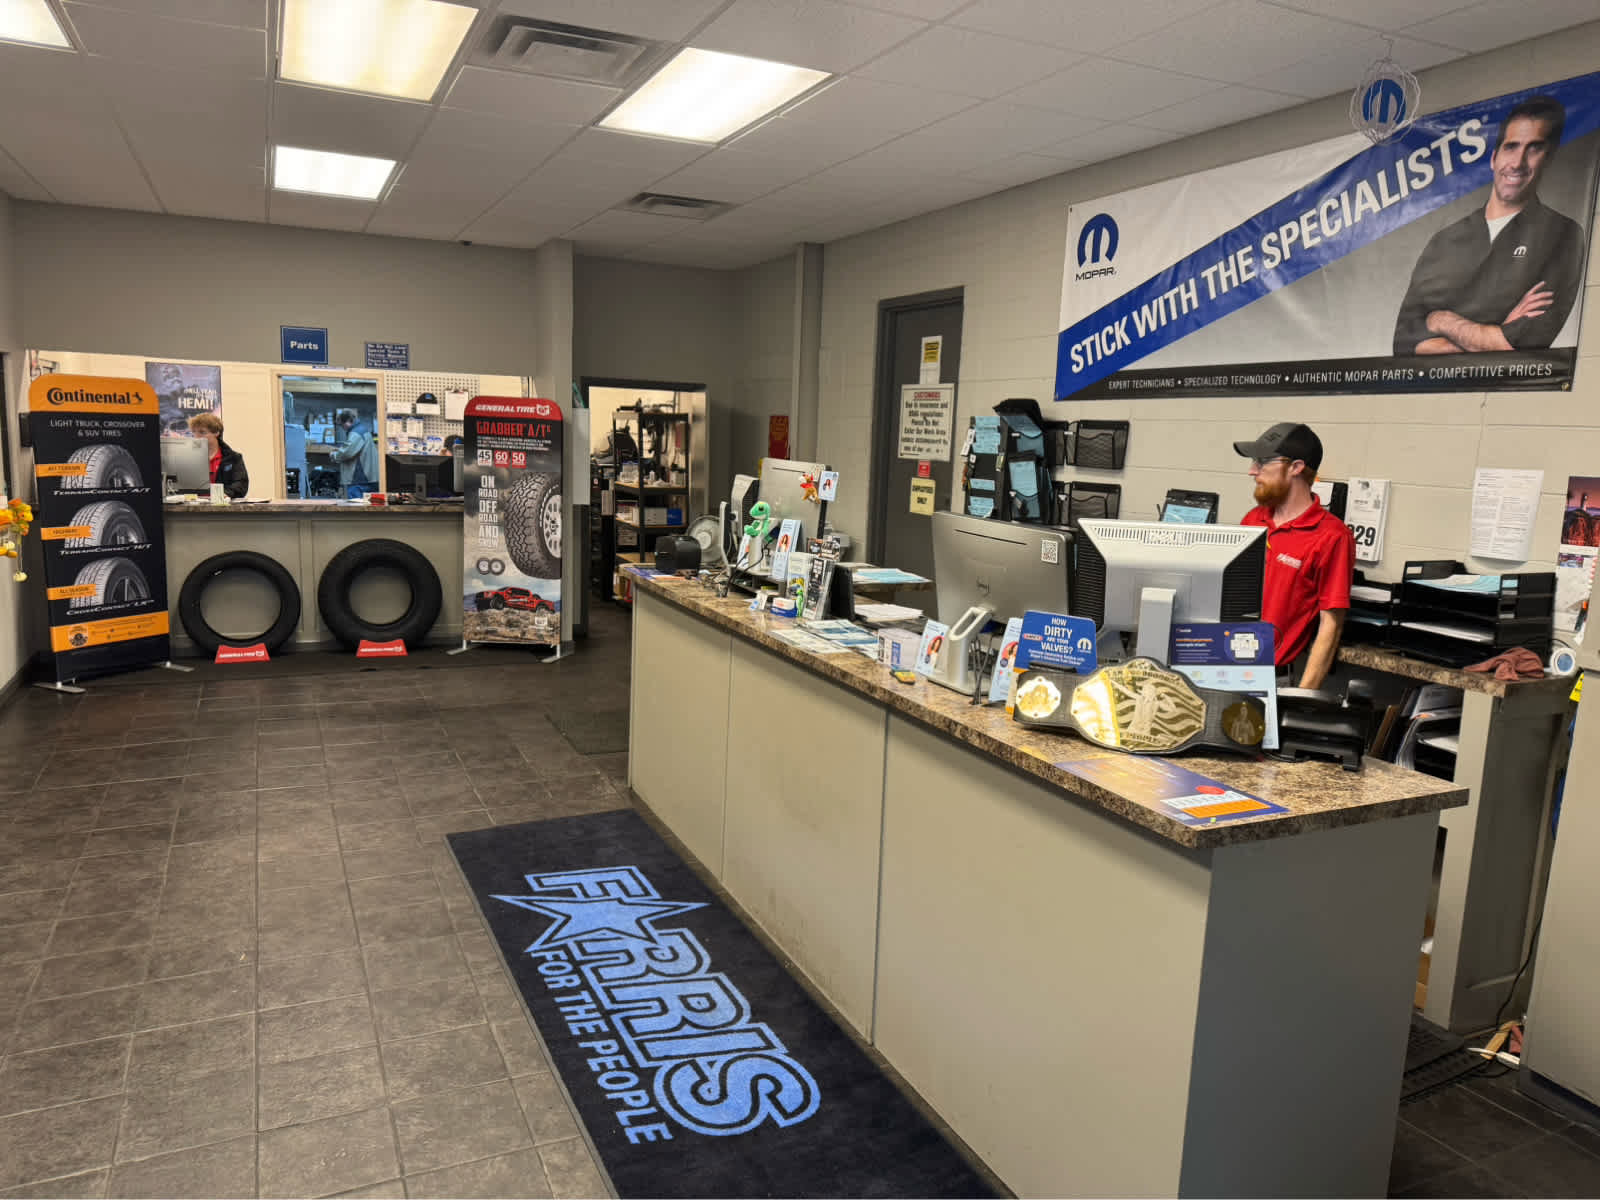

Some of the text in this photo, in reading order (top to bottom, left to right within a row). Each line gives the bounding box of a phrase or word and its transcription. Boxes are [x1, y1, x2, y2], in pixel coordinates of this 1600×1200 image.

[1070, 118, 1486, 374] STICK WITH THE SPECIALISTS
[1075, 267, 1115, 281] MOPAR
[290, 340, 319, 350] Parts
[1108, 363, 1553, 389] EXPERT TECHNICIANS SPECIALIZED TECHNOLOGY AUTHENTIC MOPAR PARTS COMPETITIVE PRICES
[46, 387, 131, 405] Continental
[178, 397, 214, 410] HEMI!
[475, 404, 515, 412] GENERAL
[479, 451, 491, 460] 45
[495, 451, 508, 460] 60
[512, 452, 525, 461] 50
[481, 475, 495, 488] ON
[478, 488, 498, 497] ROAD
[479, 500, 497, 513] OFF
[478, 513, 498, 522] ROAD
[479, 525, 498, 537] AND
[1051, 616, 1067, 626] HOW
[1044, 625, 1073, 639] DIRTY
[1041, 641, 1074, 654] VALVES?
[530, 950, 674, 1145] FOR THE PEOPLE
